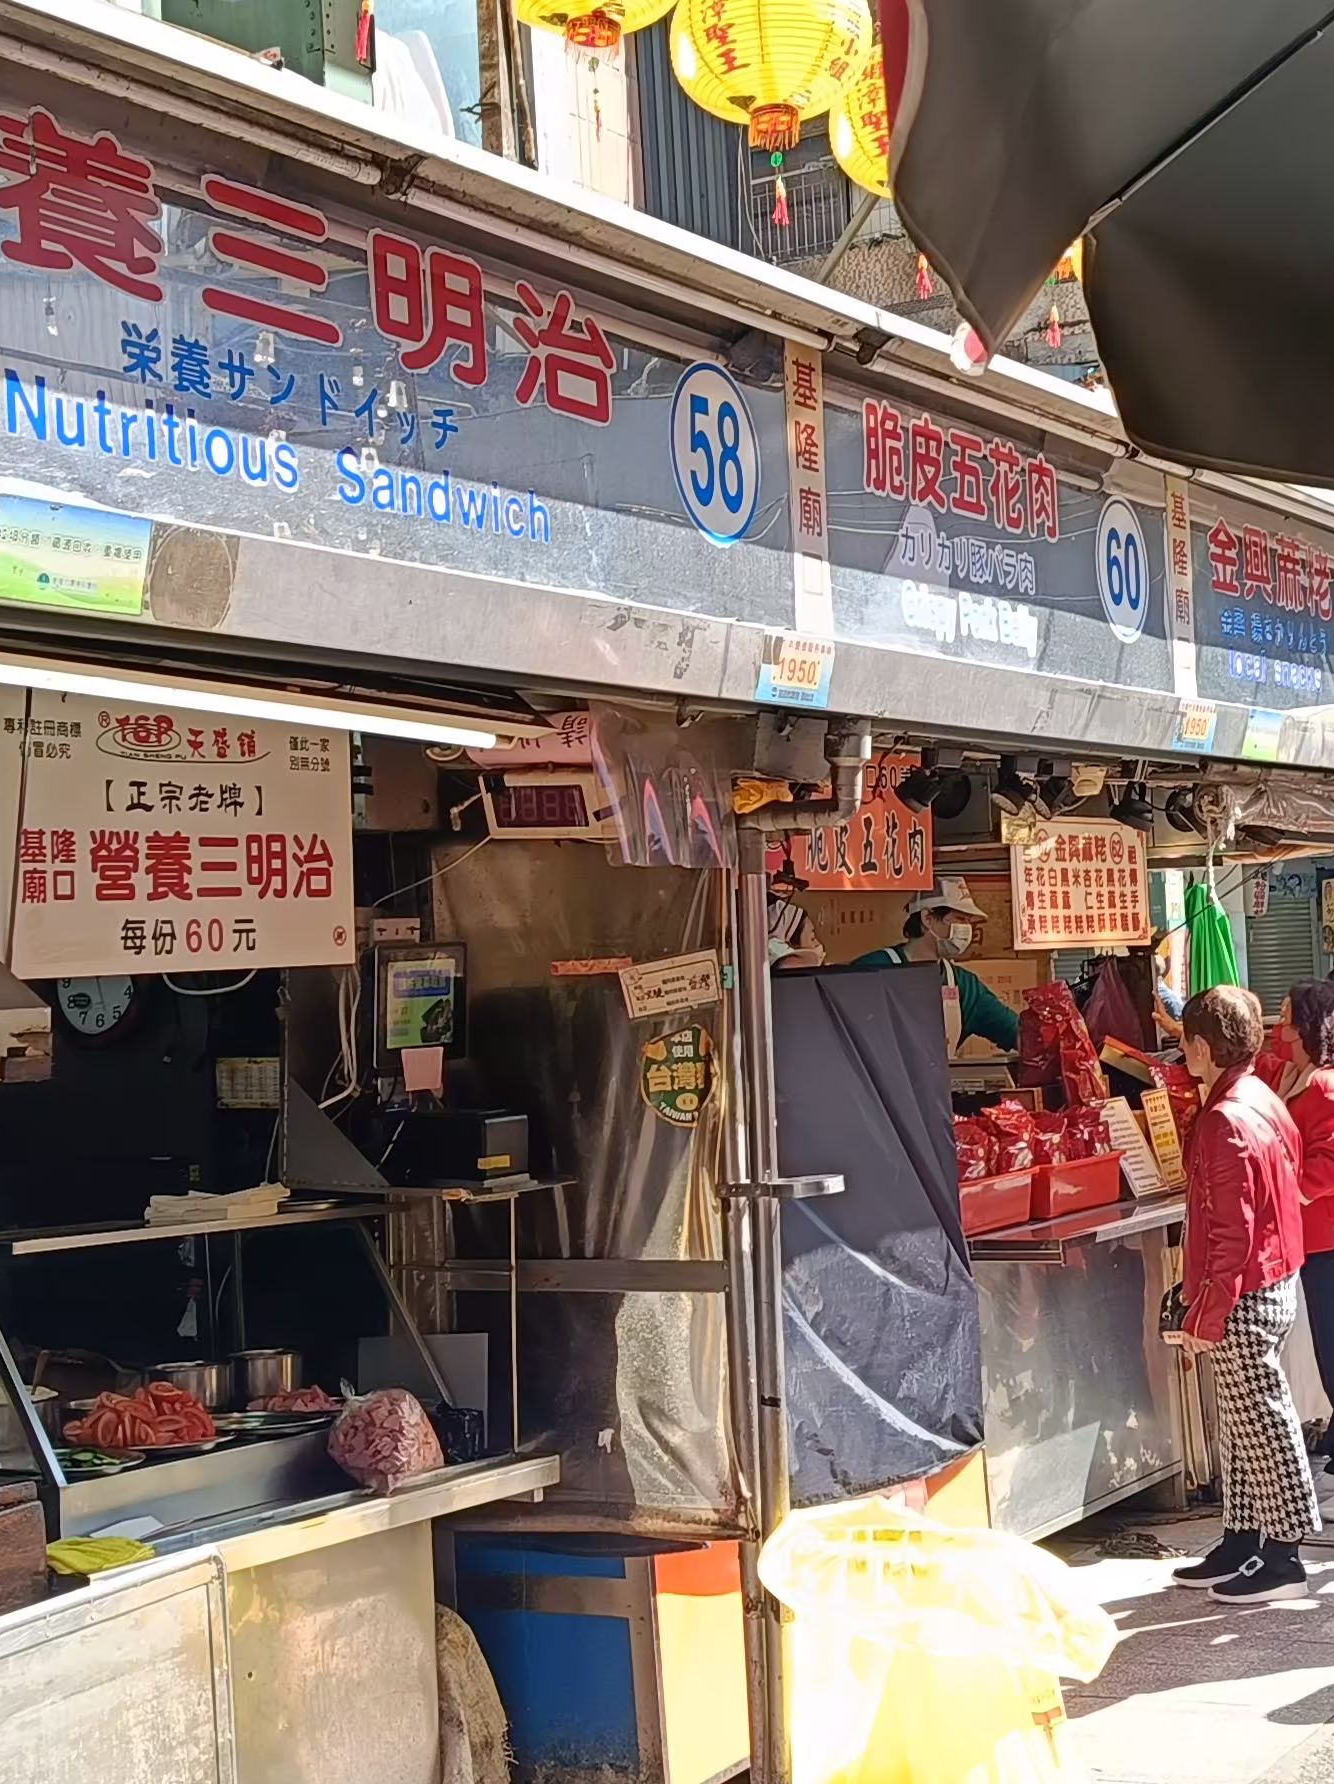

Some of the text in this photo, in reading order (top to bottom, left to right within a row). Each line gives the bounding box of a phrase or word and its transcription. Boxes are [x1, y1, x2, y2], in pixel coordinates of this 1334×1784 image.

[121, 321, 459, 450] 栄養サンドイッチ
[4, 367, 552, 544] Nutritious Sandwich
[689, 395, 744, 514] 58
[863, 399, 1060, 544] 脆皮五花肉
[1106, 528, 1142, 612] 60
[779, 657, 817, 683] 1950
[89, 829, 334, 902] 營養三明治
